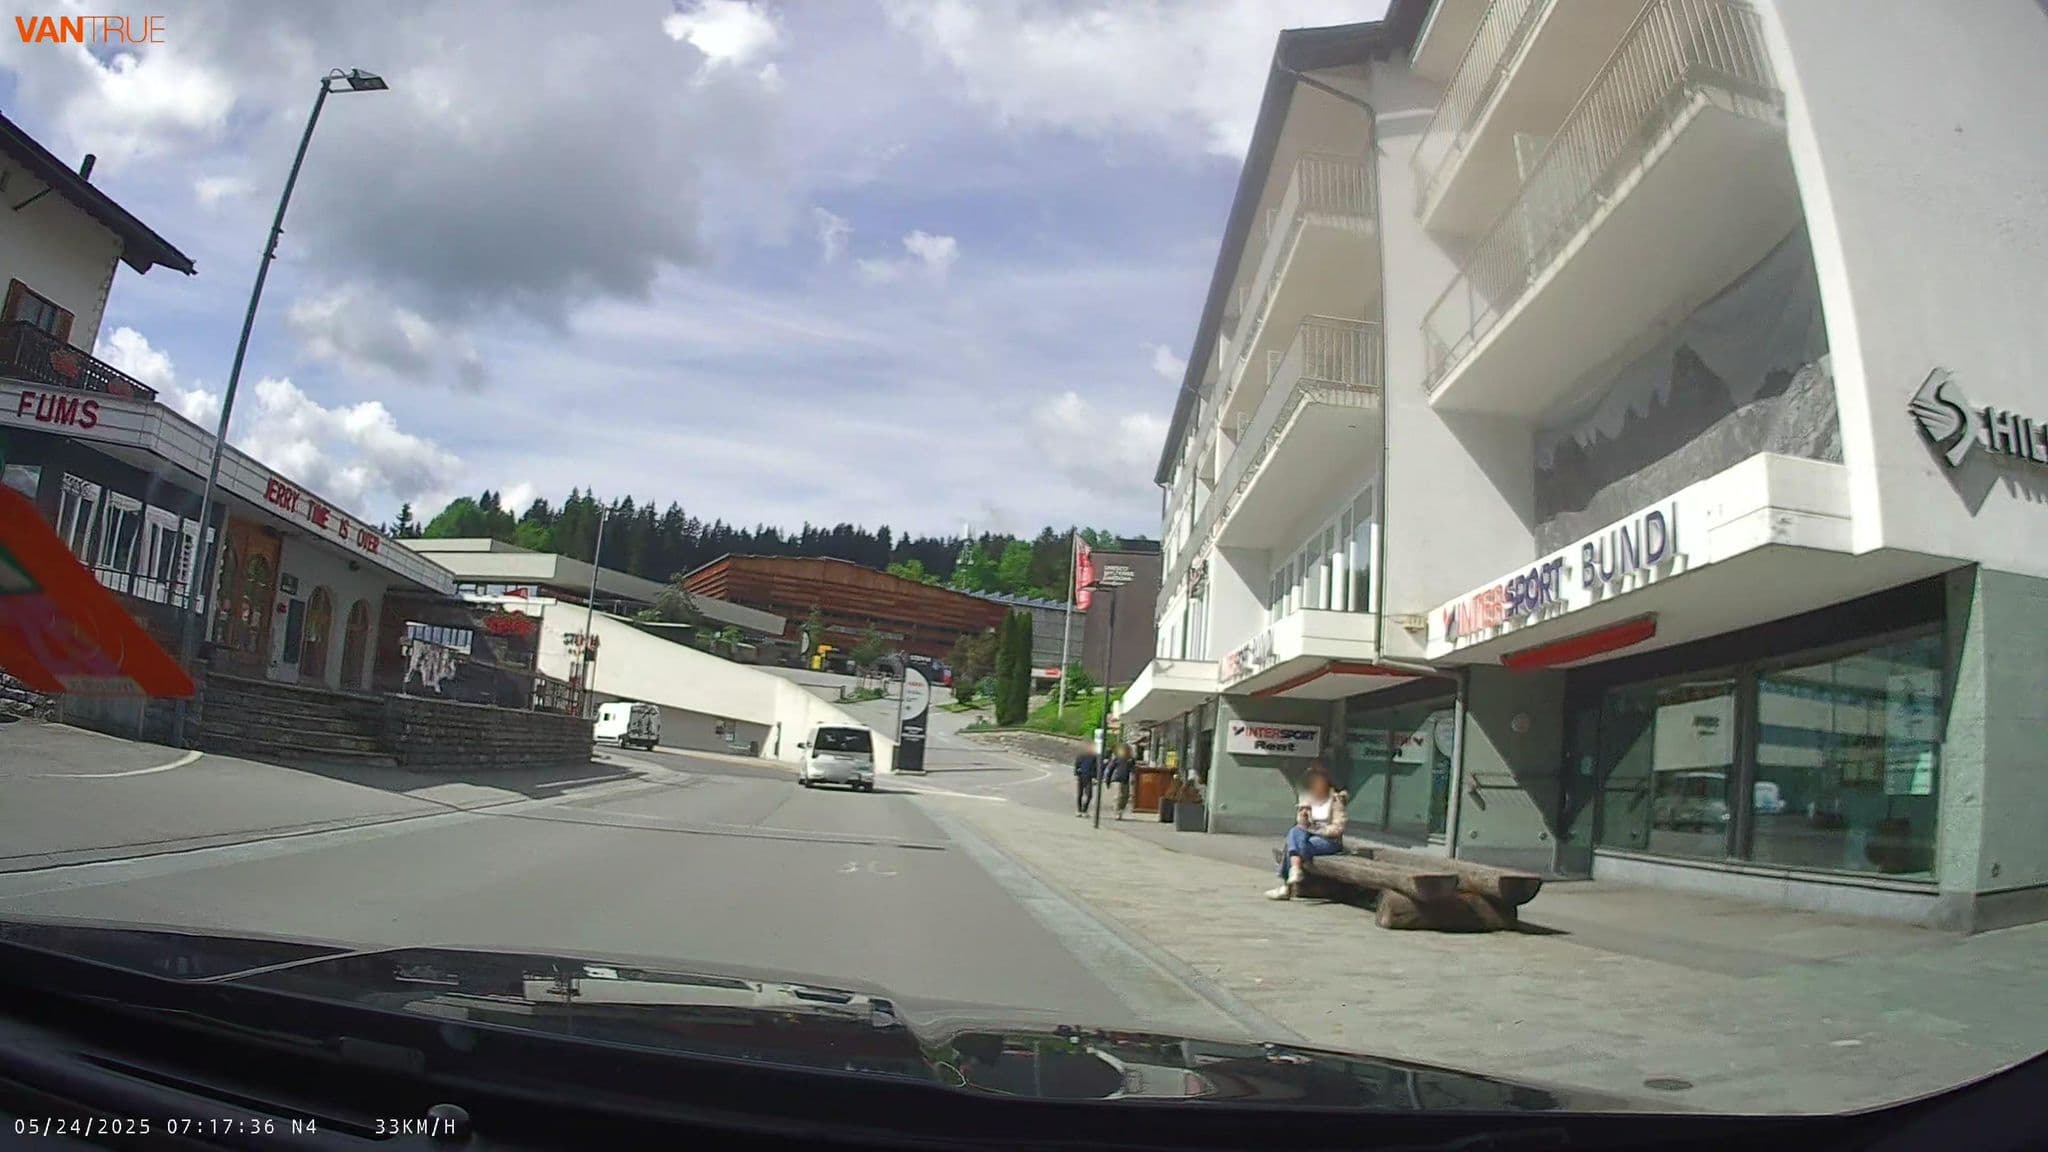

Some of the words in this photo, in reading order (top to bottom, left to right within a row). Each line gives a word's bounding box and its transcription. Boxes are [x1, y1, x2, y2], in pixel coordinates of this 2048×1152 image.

[339, 517, 351, 540] IS
[1457, 555, 1564, 638] INTERSPORT
[1581, 501, 1678, 589] BUNDI
[1245, 726, 1318, 741] INTERSPORT
[1254, 740, 1296, 752] Rent
